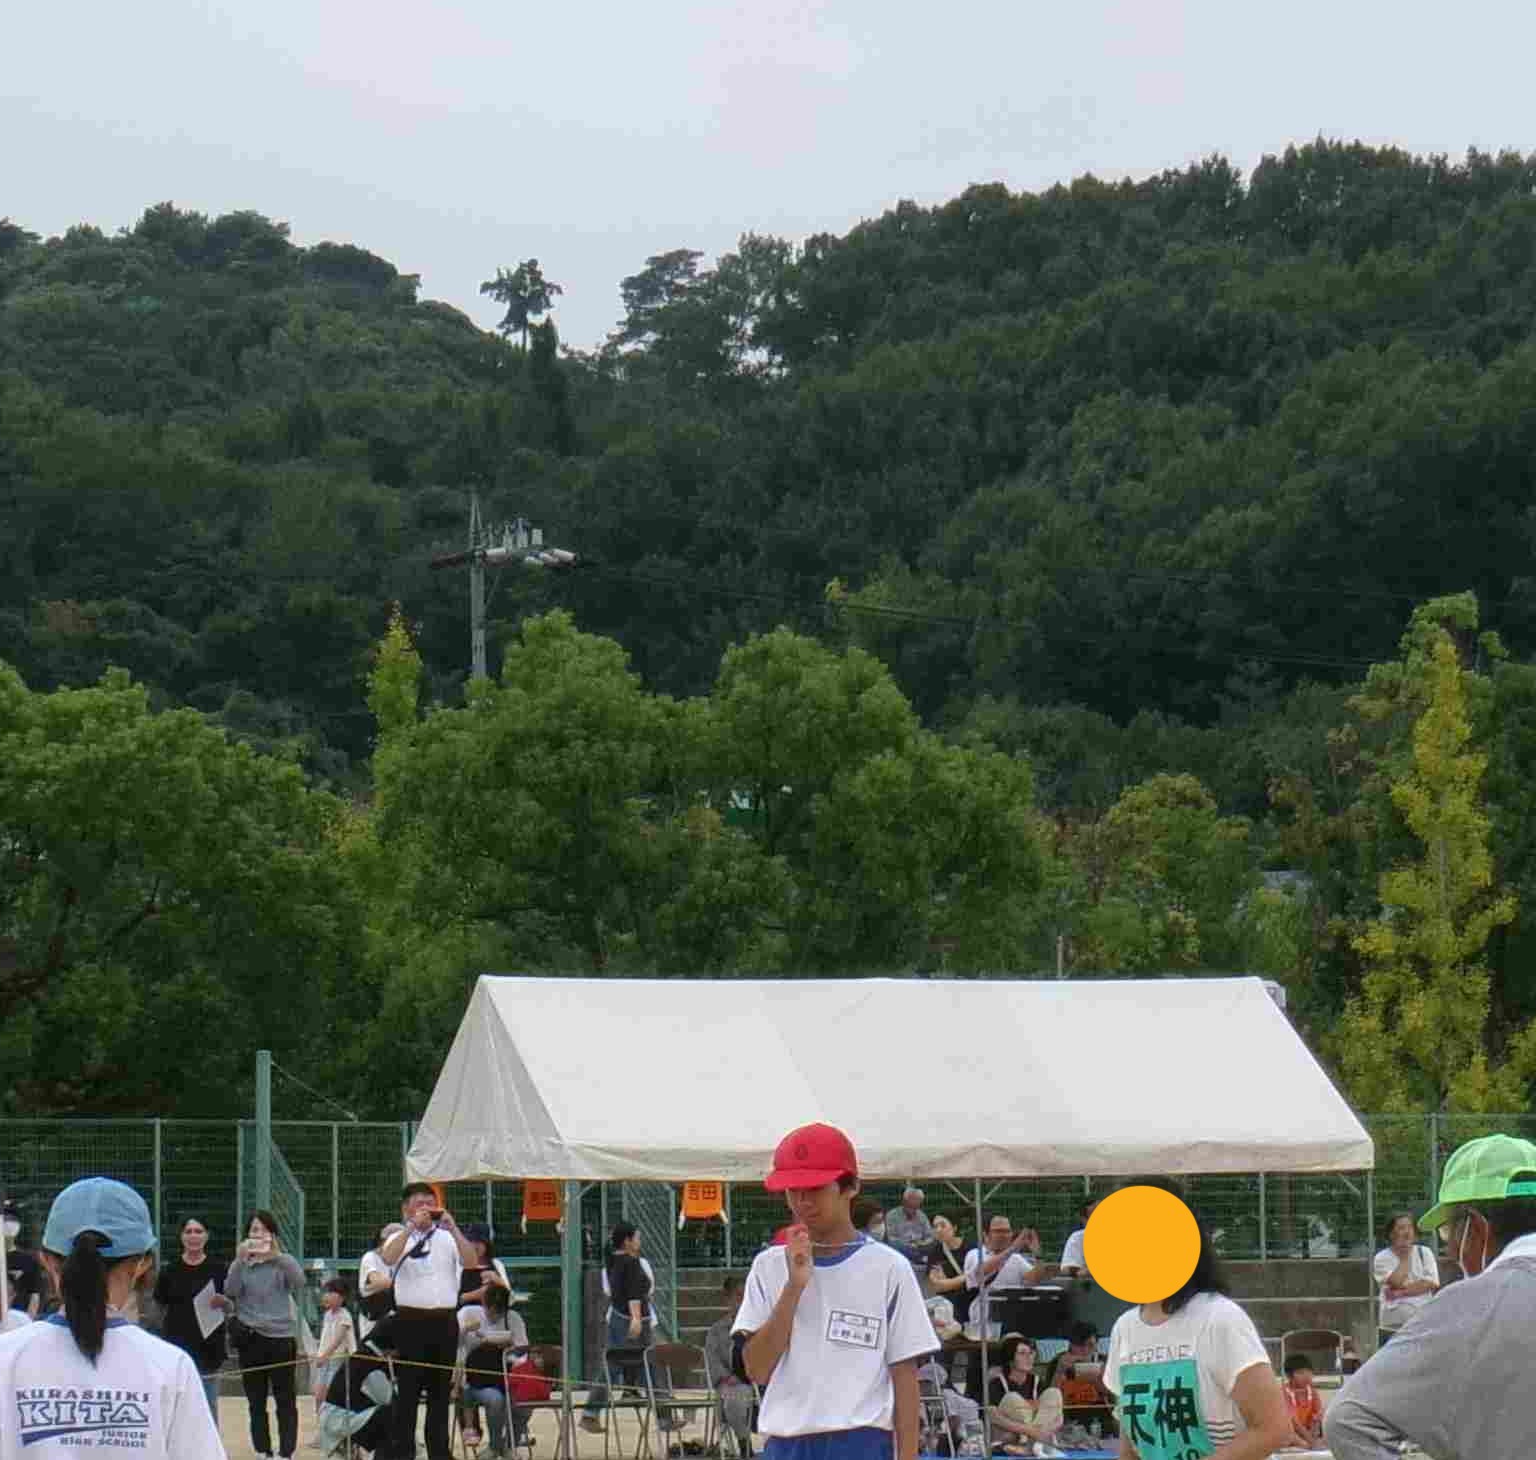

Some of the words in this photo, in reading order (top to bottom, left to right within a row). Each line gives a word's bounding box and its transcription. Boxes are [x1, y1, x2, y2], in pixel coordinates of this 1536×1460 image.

[15, 1388, 150, 1402] KURASHIKI
[17, 1400, 150, 1429] KITA
[1122, 1376, 1199, 1449] 天神
